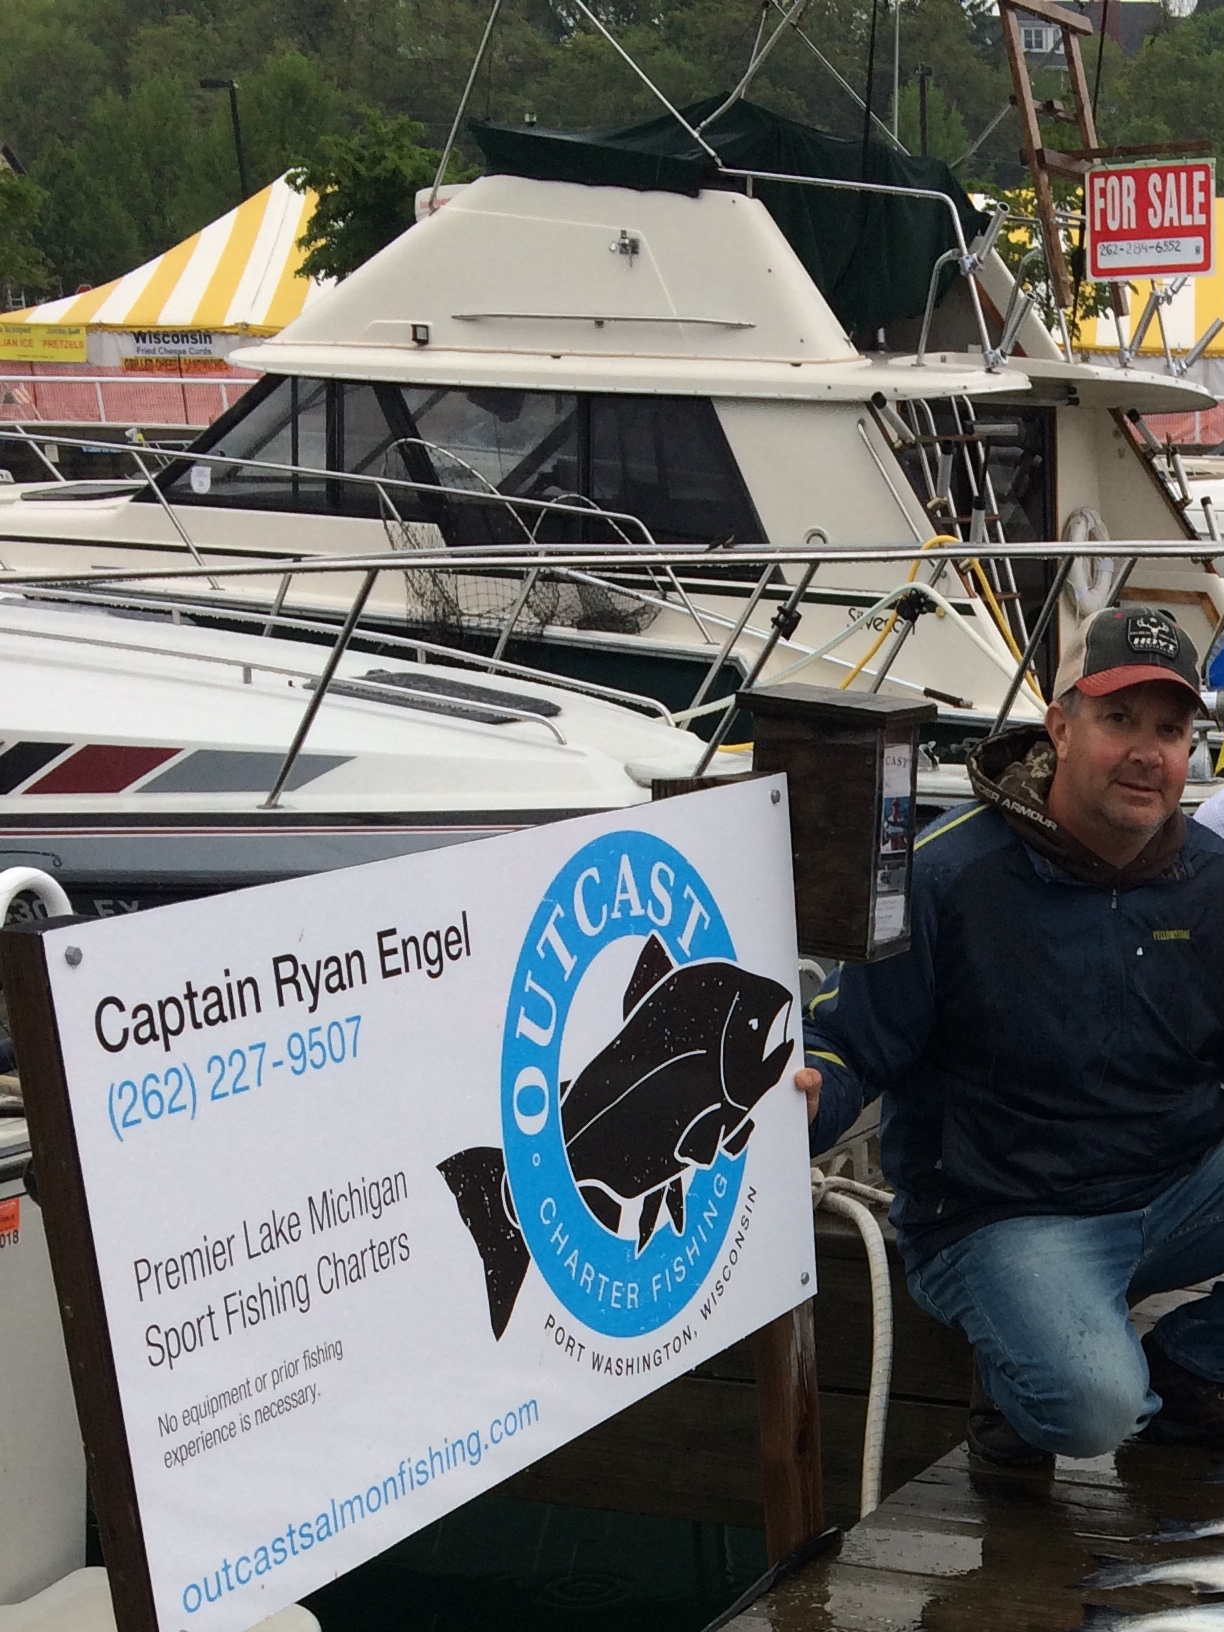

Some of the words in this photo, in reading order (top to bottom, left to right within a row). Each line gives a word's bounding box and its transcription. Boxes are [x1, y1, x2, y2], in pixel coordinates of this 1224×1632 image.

[1093, 175, 1137, 232] FOR
[1147, 170, 1207, 229] SALE
[133, 331, 213, 345] Wisconsin
[136, 347, 156, 355] Fried
[158, 347, 186, 356] Cheese
[189, 347, 212, 355] Curds
[1001, 798, 1058, 831] ARMOUR
[94, 968, 262, 1053] Captain
[272, 947, 367, 1013] Ryan
[376, 910, 472, 979] Engel
[513, 853, 711, 1136] OUTCAST
[108, 1062, 197, 1142] (262)
[207, 1014, 362, 1101] 227-9507
[133, 1233, 236, 1302] Premier
[243, 1209, 302, 1261] Lake
[307, 1171, 409, 1235] Michigan
[540, 1197, 640, 1310] CHARTER
[651, 1172, 728, 1303] FISHING
[543, 1313, 586, 1362] PORT
[591, 1325, 699, 1376] WASHINGTON,
[700, 1185, 757, 1321] WISCONSIN
[145, 1304, 220, 1371] Sport
[223, 1273, 311, 1335] Fishing
[317, 1232, 411, 1296] Charters
[157, 1413, 179, 1438] No
[182, 1377, 253, 1426] equipment
[254, 1373, 268, 1393] or
[271, 1358, 301, 1390] prior
[302, 1339, 344, 1371] fishing
[163, 1420, 237, 1469] experience
[239, 1412, 252, 1433] is
[254, 1383, 322, 1427] necessary.
[182, 1399, 540, 1615] outcastsalmonfishing.com
